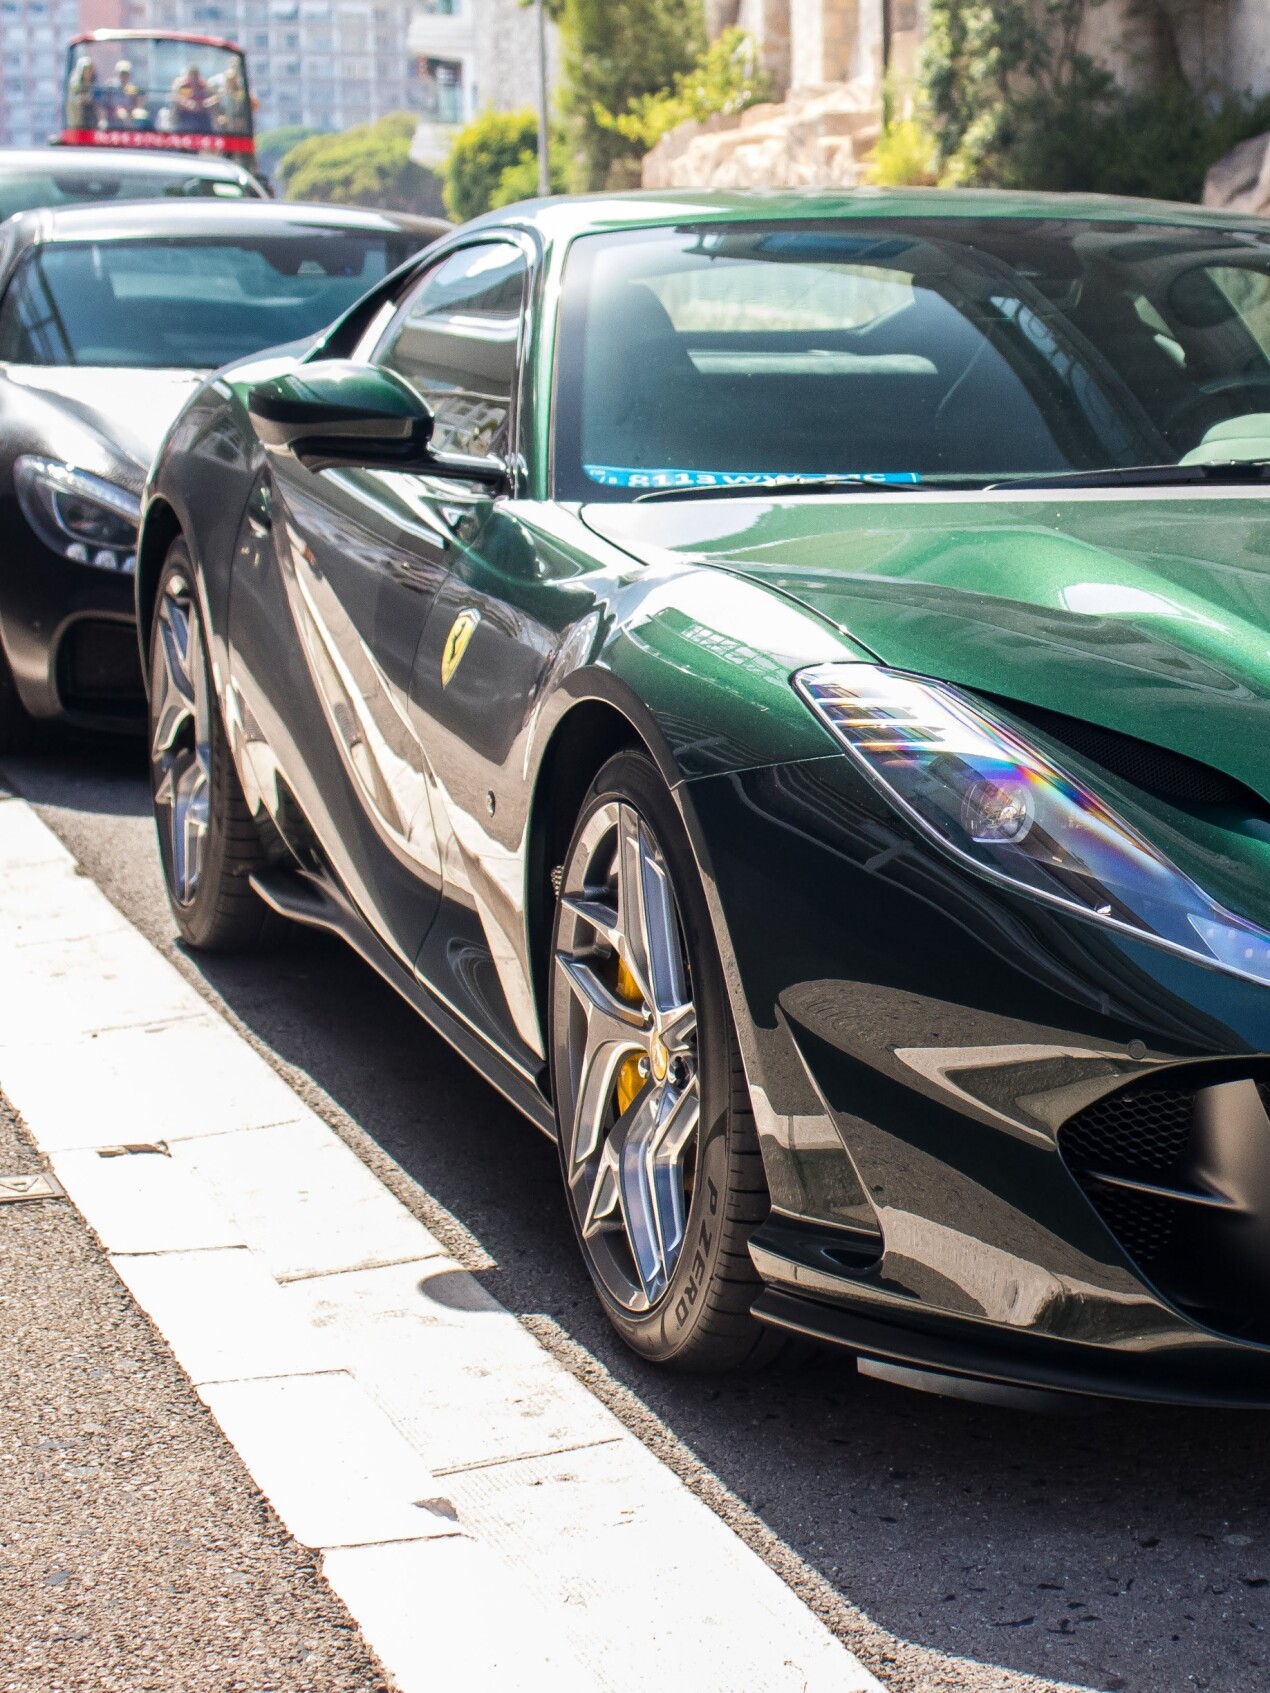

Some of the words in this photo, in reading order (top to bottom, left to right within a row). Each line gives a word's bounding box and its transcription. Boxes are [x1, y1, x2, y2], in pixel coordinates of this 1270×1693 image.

[628, 473, 717, 487] 8113
[707, 1176, 718, 1216] P
[675, 1219, 712, 1327] ZERO
